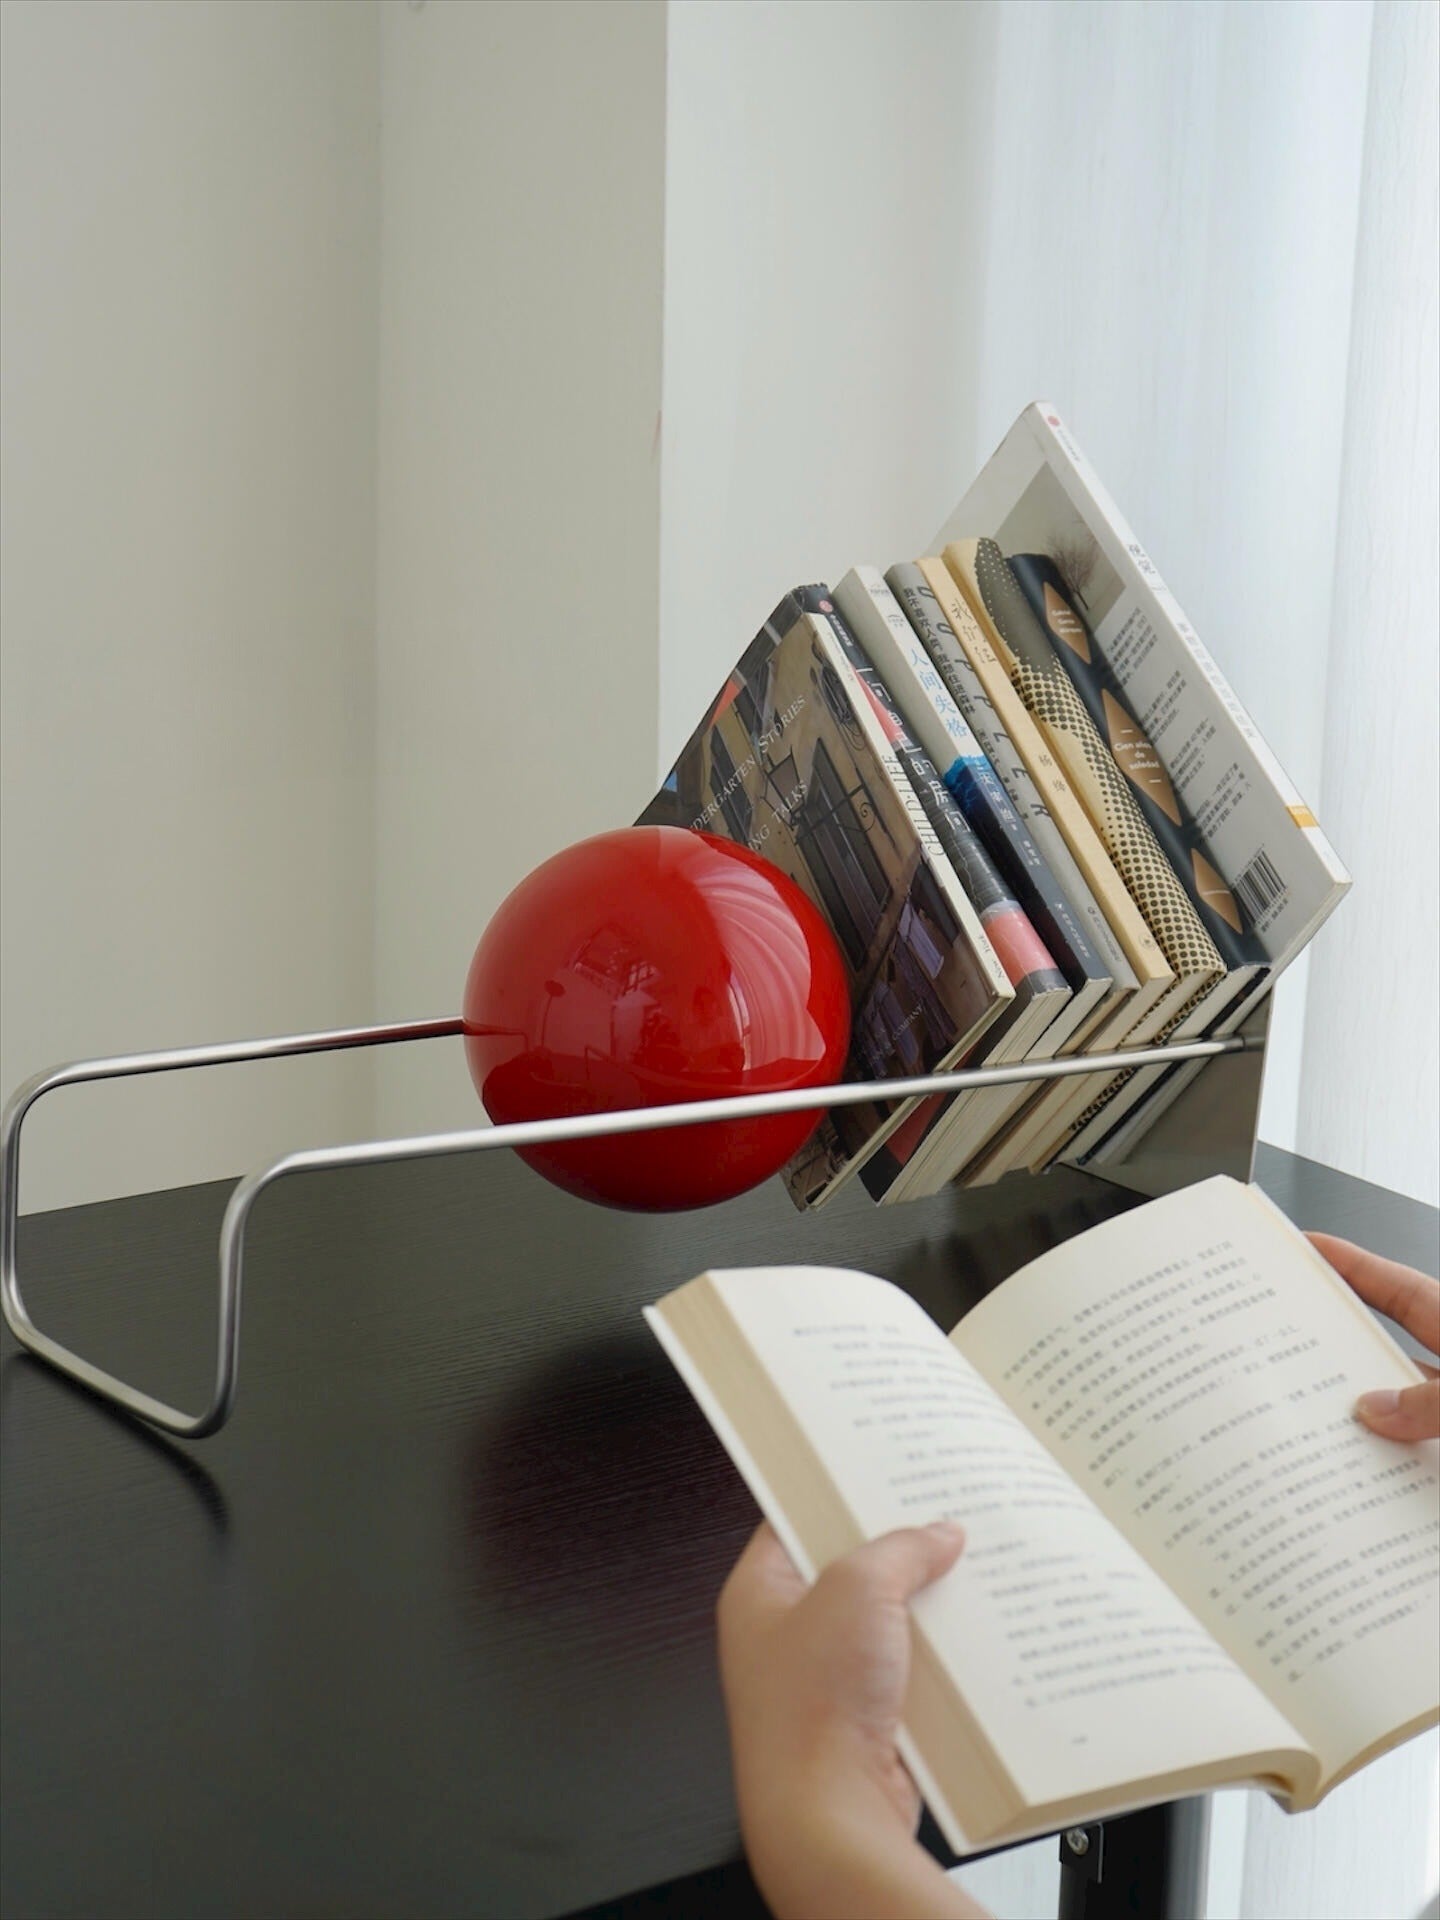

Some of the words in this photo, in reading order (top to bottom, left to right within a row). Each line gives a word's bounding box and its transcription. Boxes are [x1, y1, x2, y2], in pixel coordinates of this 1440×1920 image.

[911, 649, 968, 738] 人间失格
[690, 753, 757, 830] DERGARTEN
[758, 695, 807, 754] STORIES
[771, 779, 808, 824] TALKS
[855, 667, 972, 833] 一间自己的房间
